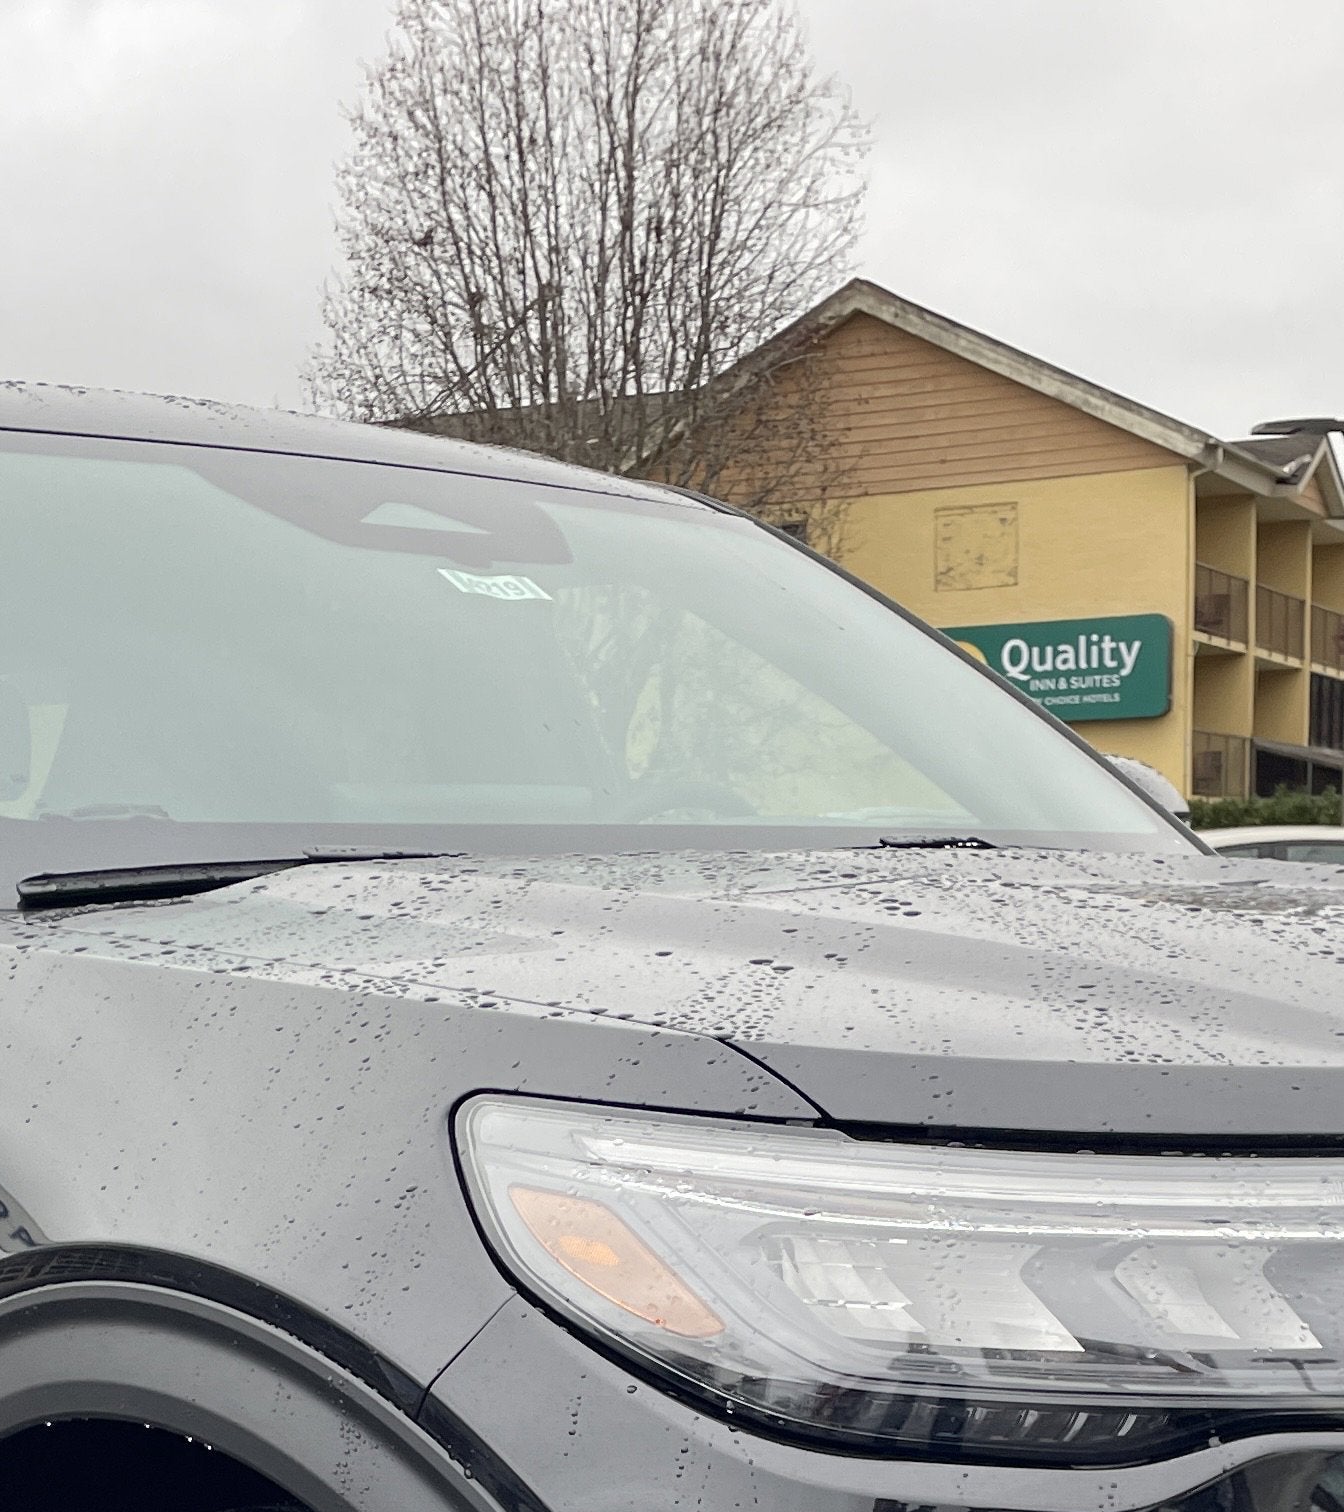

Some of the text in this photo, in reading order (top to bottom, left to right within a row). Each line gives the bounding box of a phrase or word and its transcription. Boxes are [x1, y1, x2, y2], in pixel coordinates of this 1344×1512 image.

[1001, 634, 1141, 681] Quality
[1030, 674, 1120, 691] INN & SUITES
[1045, 695, 1080, 706] CHOICE
